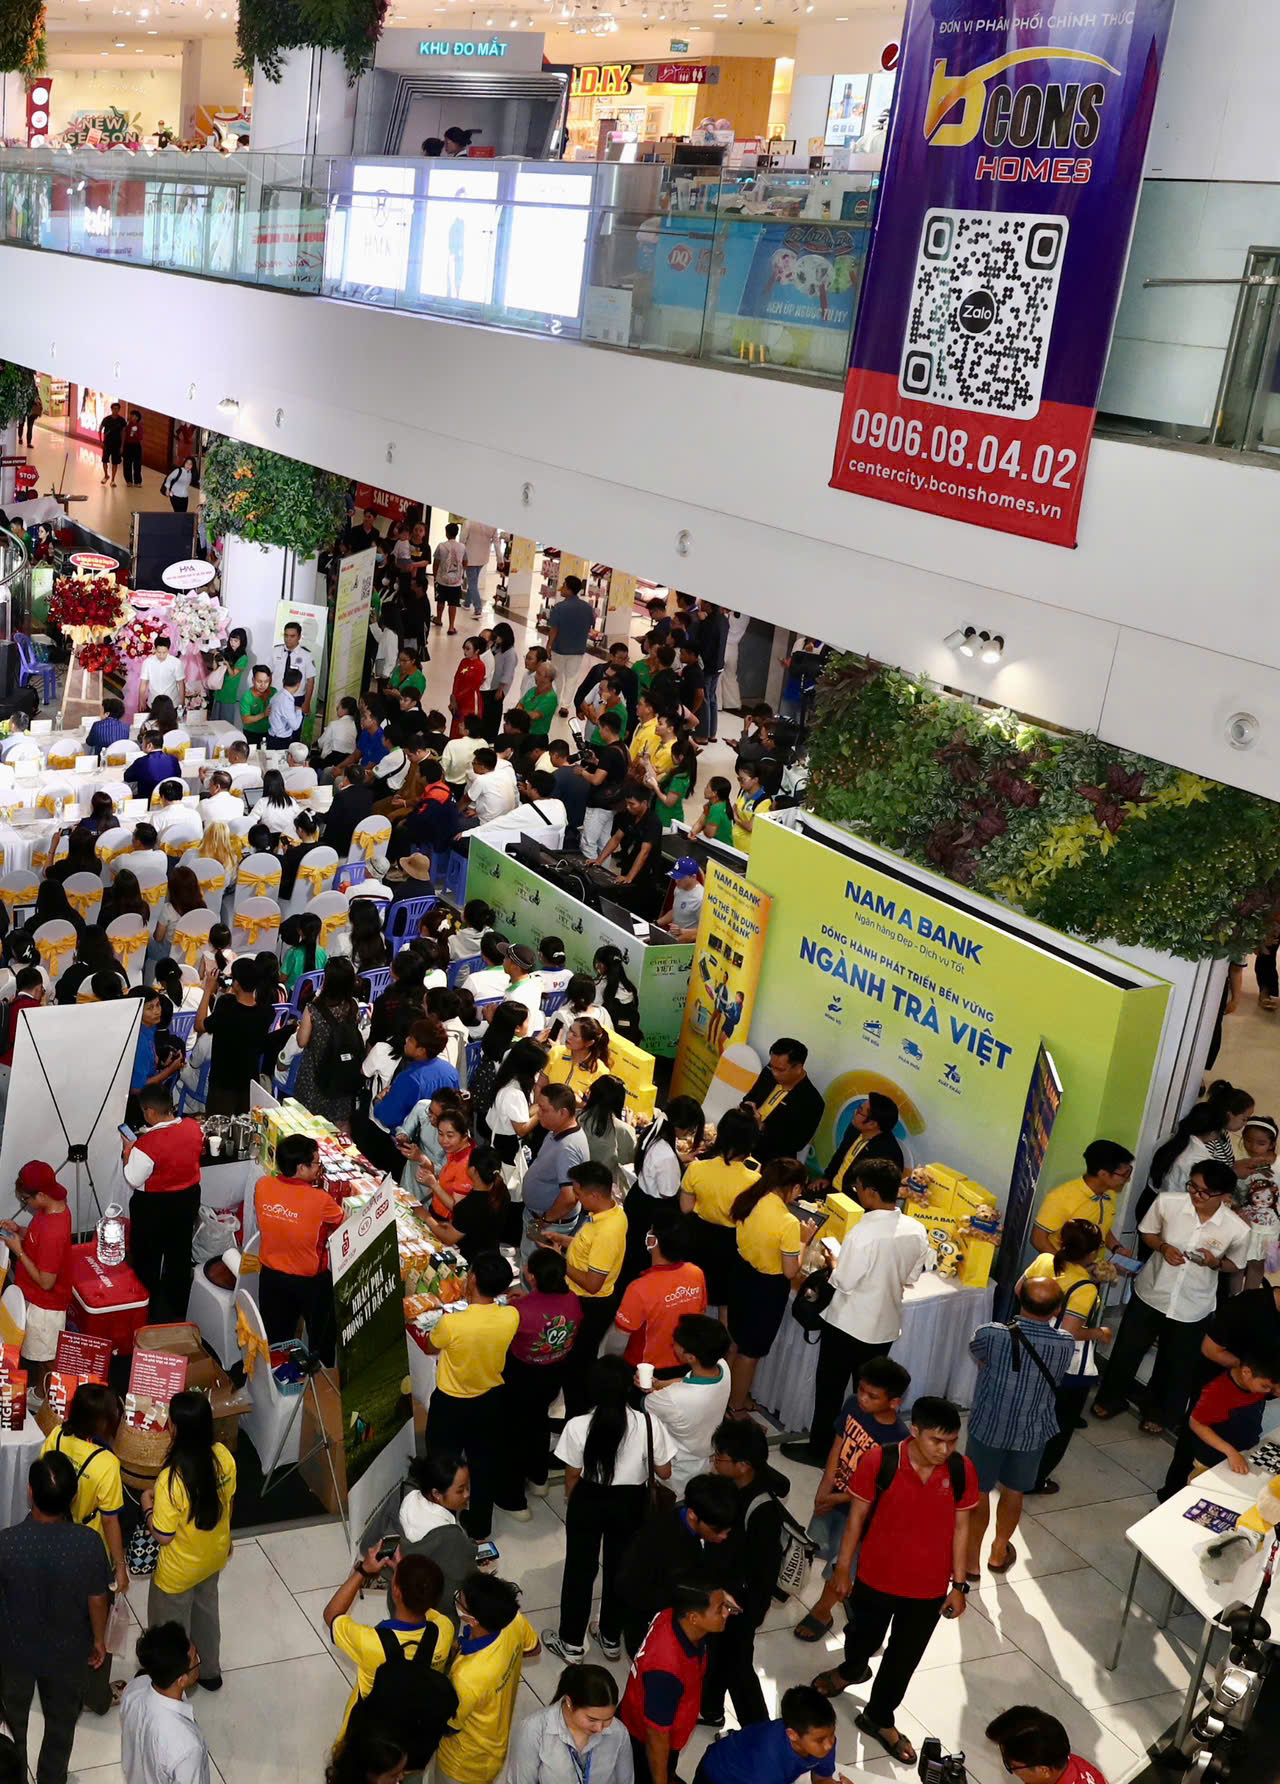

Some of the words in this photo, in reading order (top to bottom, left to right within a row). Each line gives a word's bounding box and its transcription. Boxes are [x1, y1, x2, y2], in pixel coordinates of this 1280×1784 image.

[939, 21, 960, 34] ĐƠN
[964, 20, 973, 35] VỊ
[976, 16, 1010, 32] PHÂN
[1014, 14, 1043, 31] PHỐI
[1047, 12, 1096, 29] CHÍNH
[1101, 9, 1135, 26] THỨC
[420, 41, 450, 55] KHU
[453, 42, 475, 56] ĐO
[477, 36, 507, 56] MẮT
[65, 131, 137, 145] SESON
[82, 118, 122, 130] NEW
[975, 155, 1093, 184] HOMES
[962, 304, 993, 320] Zalo
[851, 408, 1078, 490] 0906.08.04.02
[19, 472, 37, 480] STOP
[848, 457, 1063, 520] centercity.bconshomes.vn
[373, 490, 390, 508] SALE
[713, 869, 731, 889] NAM
[732, 881, 739, 892] A
[738, 886, 761, 907] BANK
[733, 921, 751, 940] BANK
[844, 880, 896, 921] NAM
[897, 908, 913, 931] A
[917, 916, 985, 967] BANK
[854, 911, 876, 930] Ngân
[877, 923, 896, 942] hàng
[896, 933, 914, 951] Đẹp
[919, 944, 938, 960] Dịch
[938, 956, 950, 968] vụ
[950, 958, 966, 975] Tốt
[821, 923, 848, 945] ĐỒNG
[849, 939, 878, 961] HÀNH
[879, 955, 906, 976] PHÁT
[907, 969, 937, 993] TRIỂN
[939, 985, 961, 1005] BỀN
[962, 998, 995, 1023] VỮNG
[799, 935, 887, 1003] NGÀNH
[891, 984, 941, 1035] TRÀ
[950, 1015, 1014, 1070] VIỆT
[913, 1212, 932, 1221] NAM
[351, 1283, 370, 1316] KHÁM
[370, 1263, 385, 1293] PHÁ
[342, 1312, 364, 1347] PHONG
[371, 1288, 385, 1311] ĐẶC
[385, 1271, 397, 1299] SẮC
[547, 1329, 567, 1345] C2
[780, 1545, 802, 1584] FASHION
